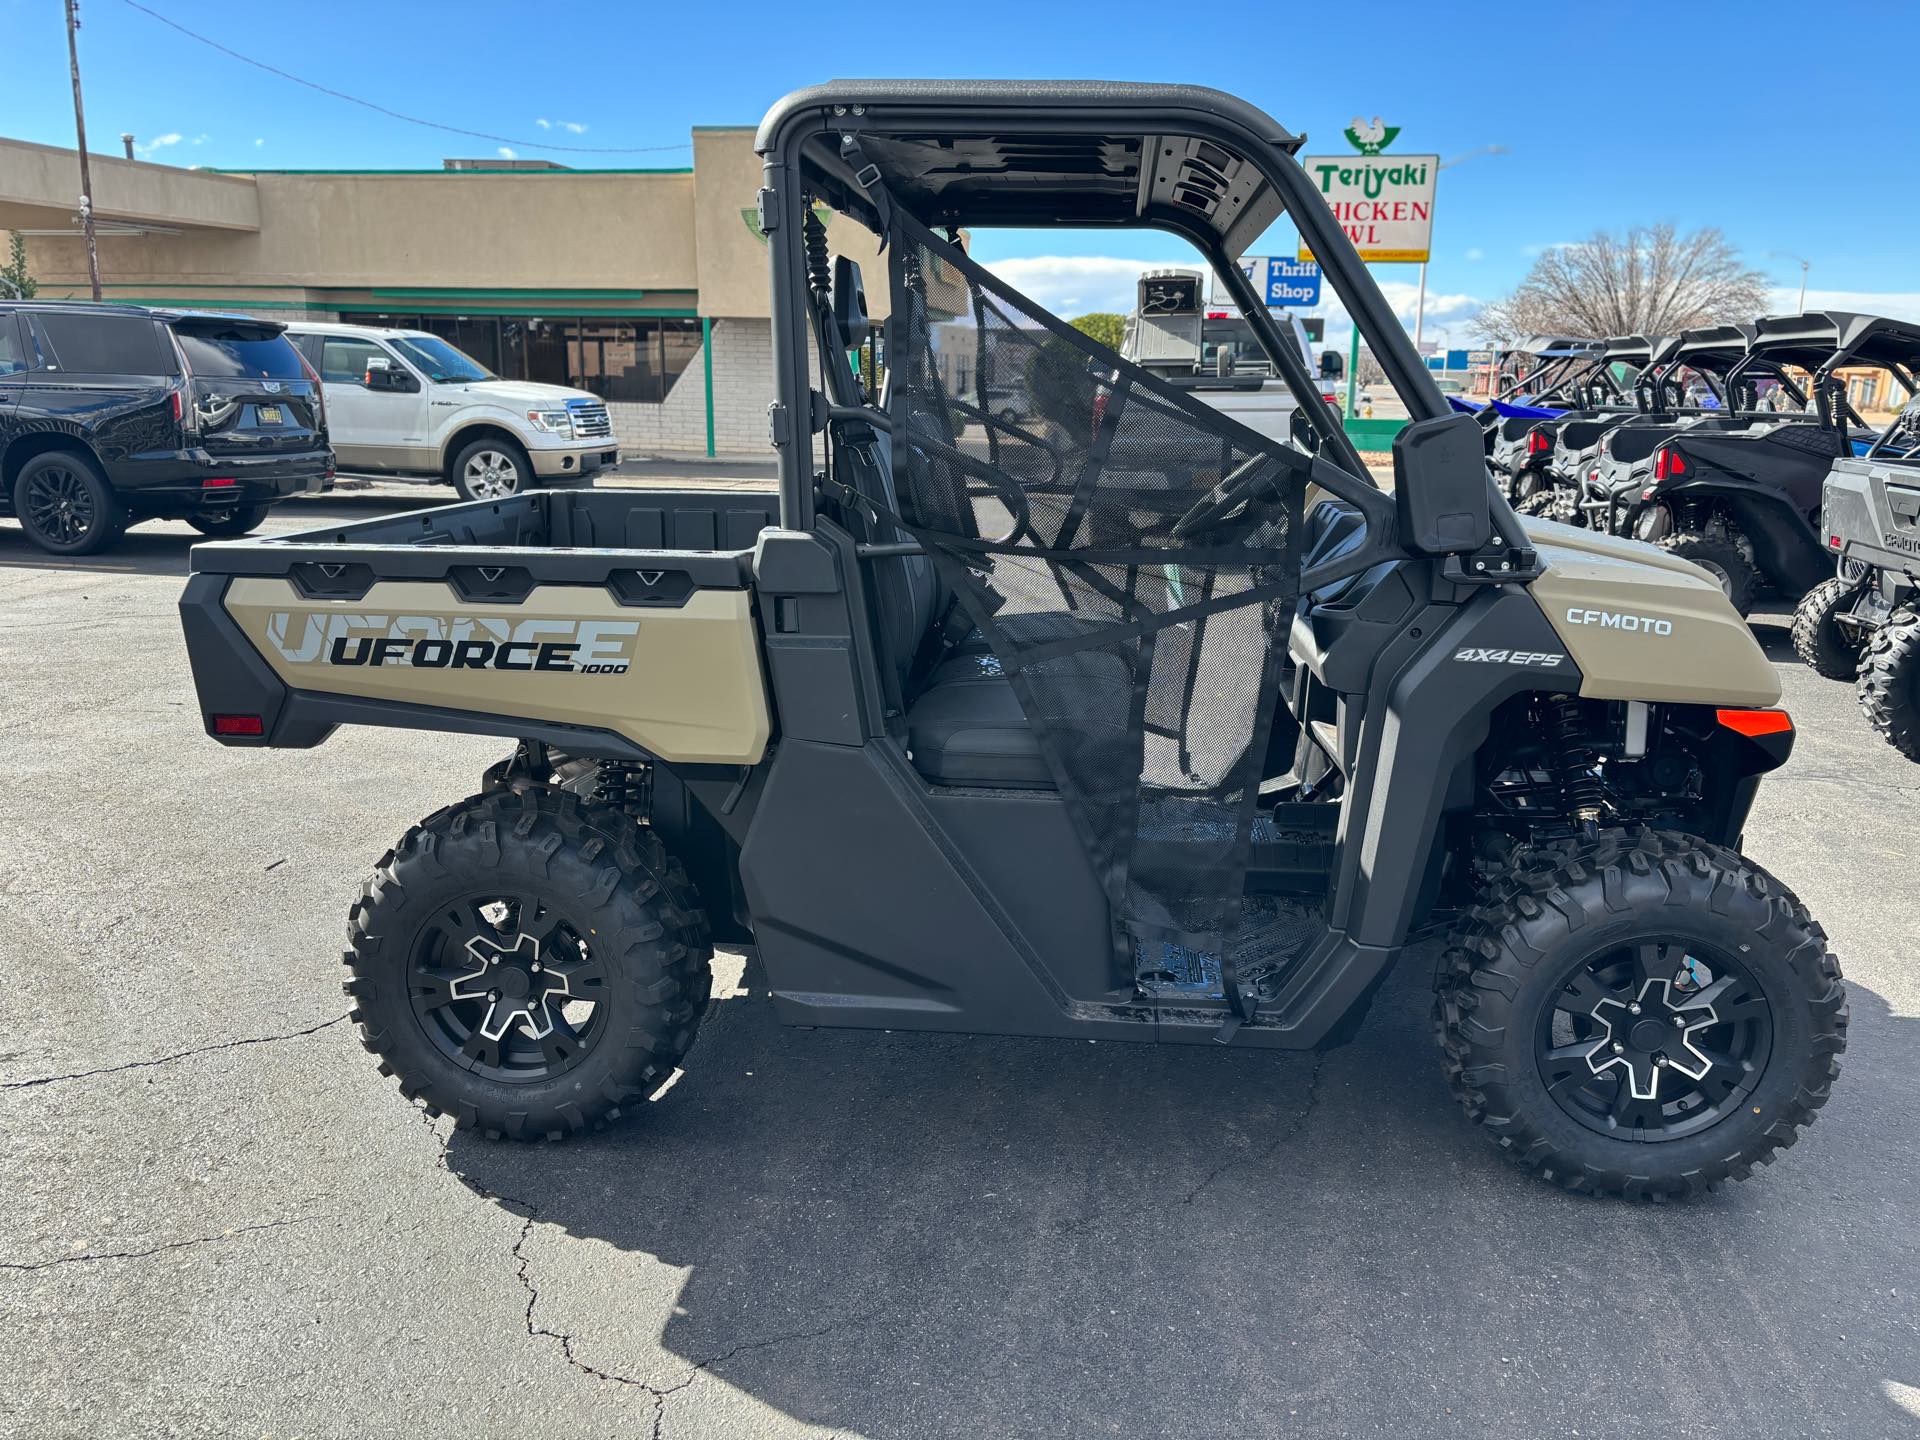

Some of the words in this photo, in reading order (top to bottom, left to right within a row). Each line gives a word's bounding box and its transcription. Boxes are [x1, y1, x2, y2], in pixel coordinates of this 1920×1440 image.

[1315, 163, 1428, 199] Teriyaki
[1327, 201, 1430, 221] HICKEN
[1271, 261, 1318, 277] Thrift
[1271, 283, 1314, 302] Shop
[1566, 607, 1672, 636] CFMOTO
[330, 637, 581, 672] UFORCE
[580, 664, 628, 674] 1000
